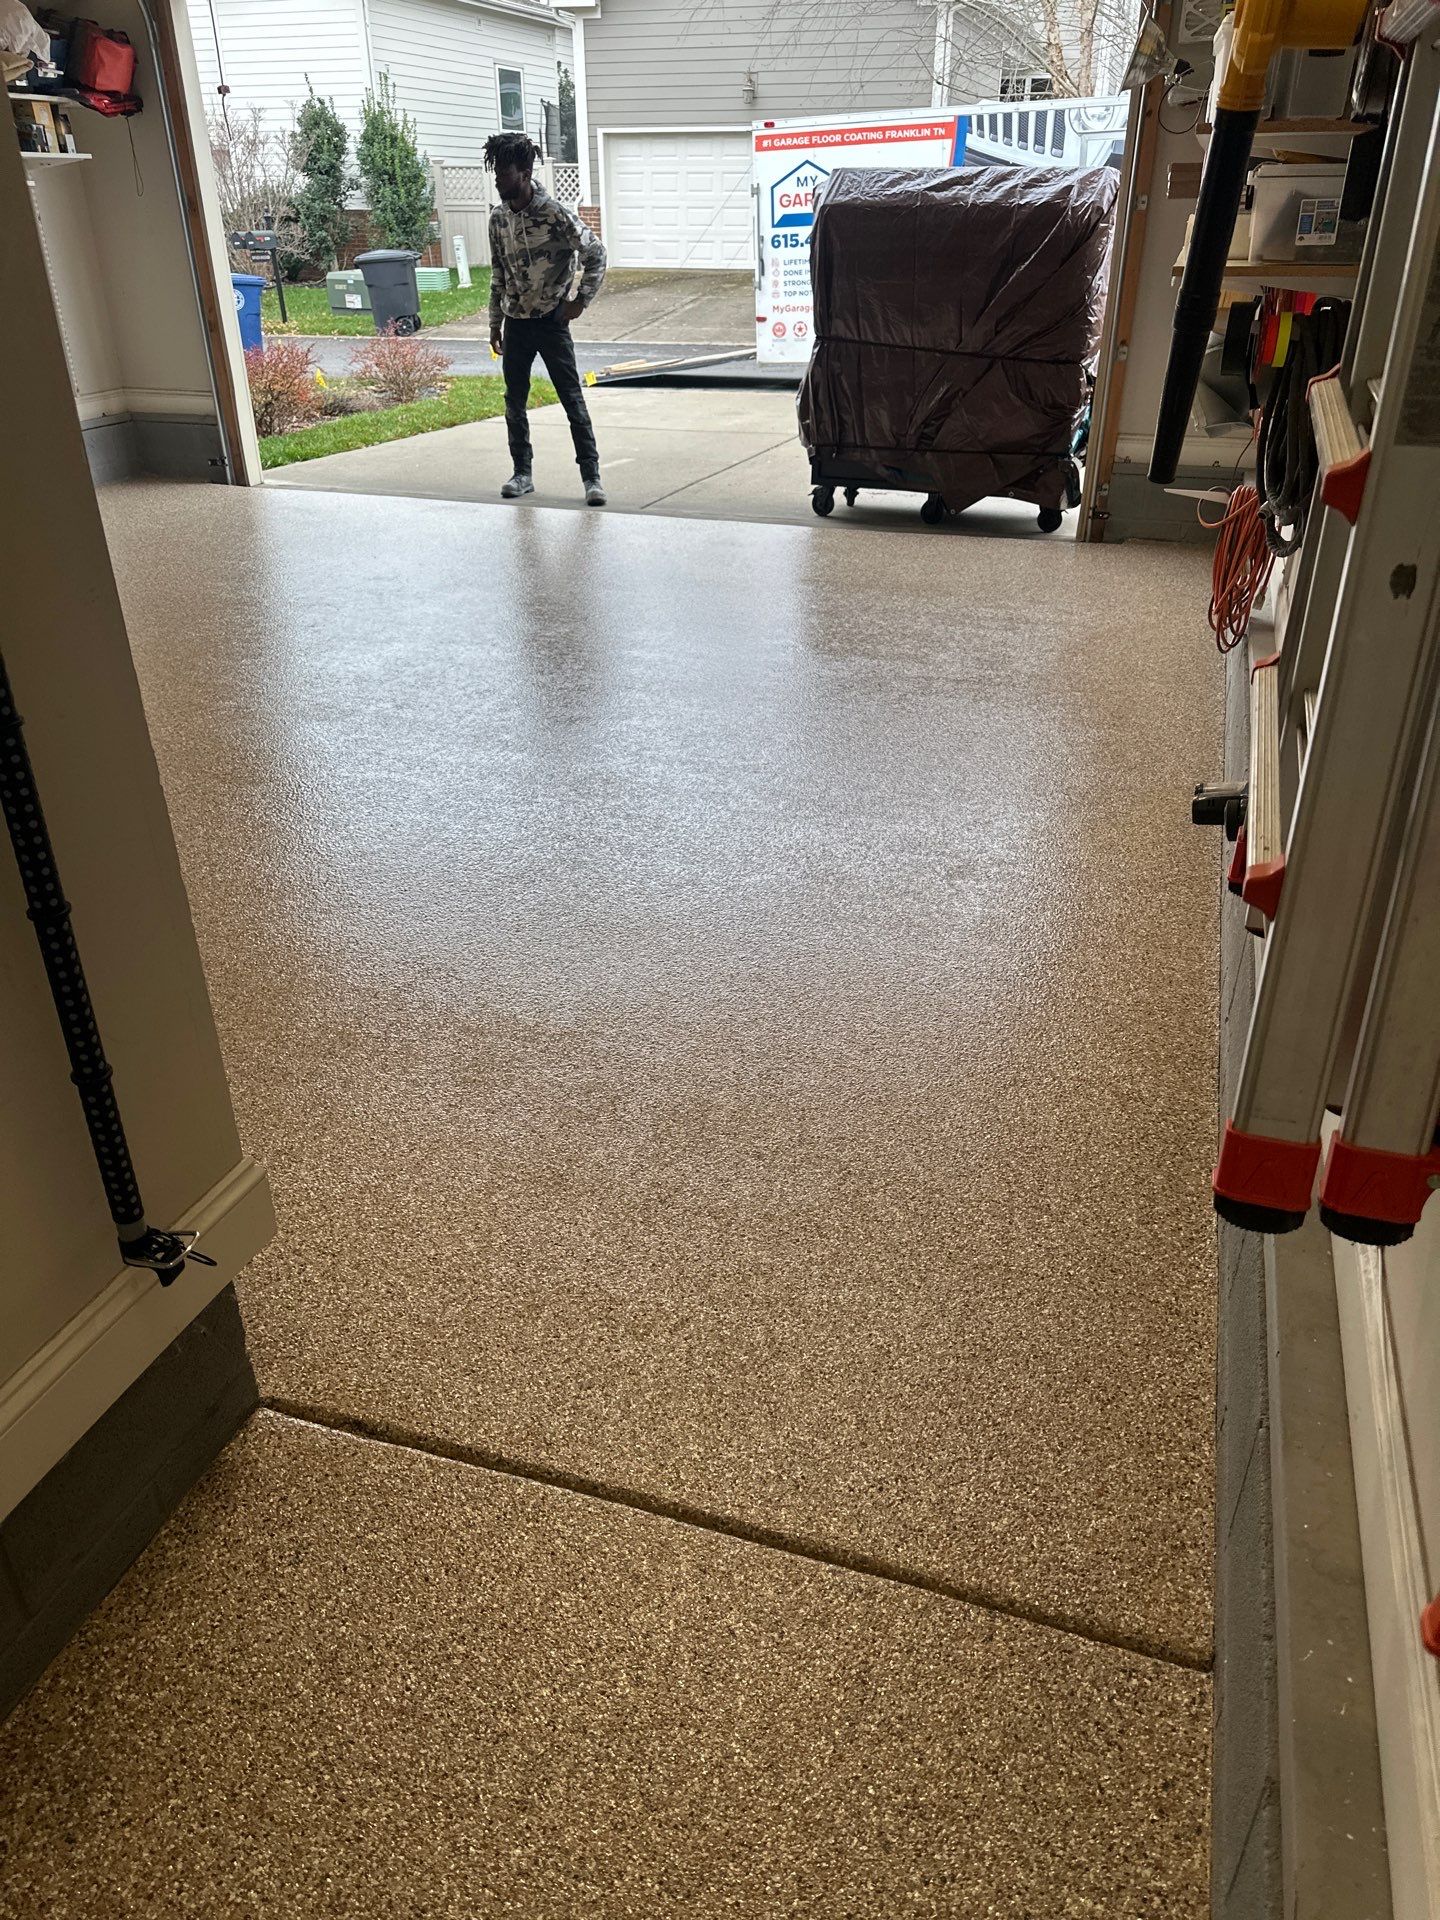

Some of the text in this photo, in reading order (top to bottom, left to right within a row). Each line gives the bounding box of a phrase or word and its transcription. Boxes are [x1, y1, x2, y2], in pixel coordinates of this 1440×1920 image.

[762, 127, 946, 148] #1 GARAGE FLOOR COATING FRANKLIN TN
[797, 176, 818, 187] MY
